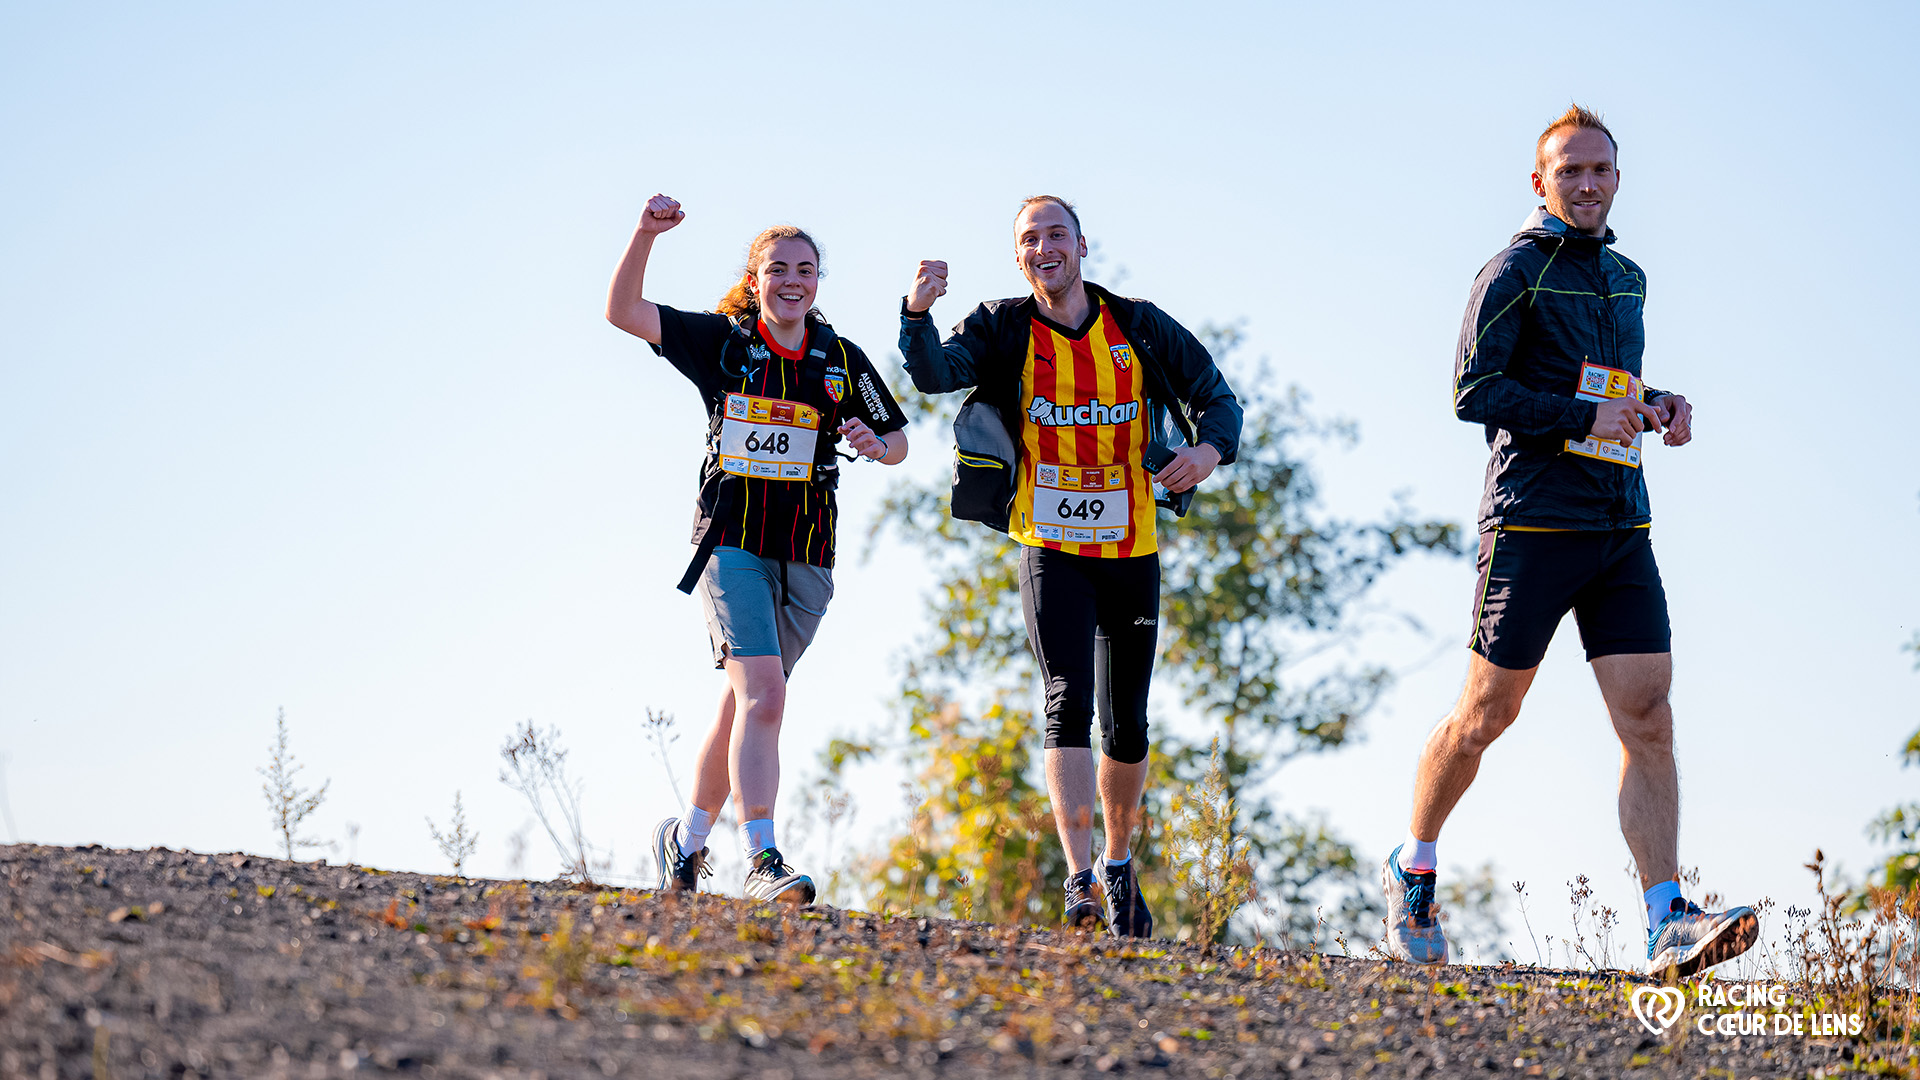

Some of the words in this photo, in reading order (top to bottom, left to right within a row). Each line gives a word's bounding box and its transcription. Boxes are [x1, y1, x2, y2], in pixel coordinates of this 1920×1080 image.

[1113, 351, 1126, 369] RCL
[825, 380, 838, 401] RCL
[1610, 375, 1620, 390] 5
[858, 378, 876, 413] OYELLES
[751, 401, 761, 415] 5
[1027, 397, 1139, 426] Auchan
[744, 430, 790, 455] 648
[1061, 469, 1071, 482] 5
[1057, 497, 1105, 521] 649
